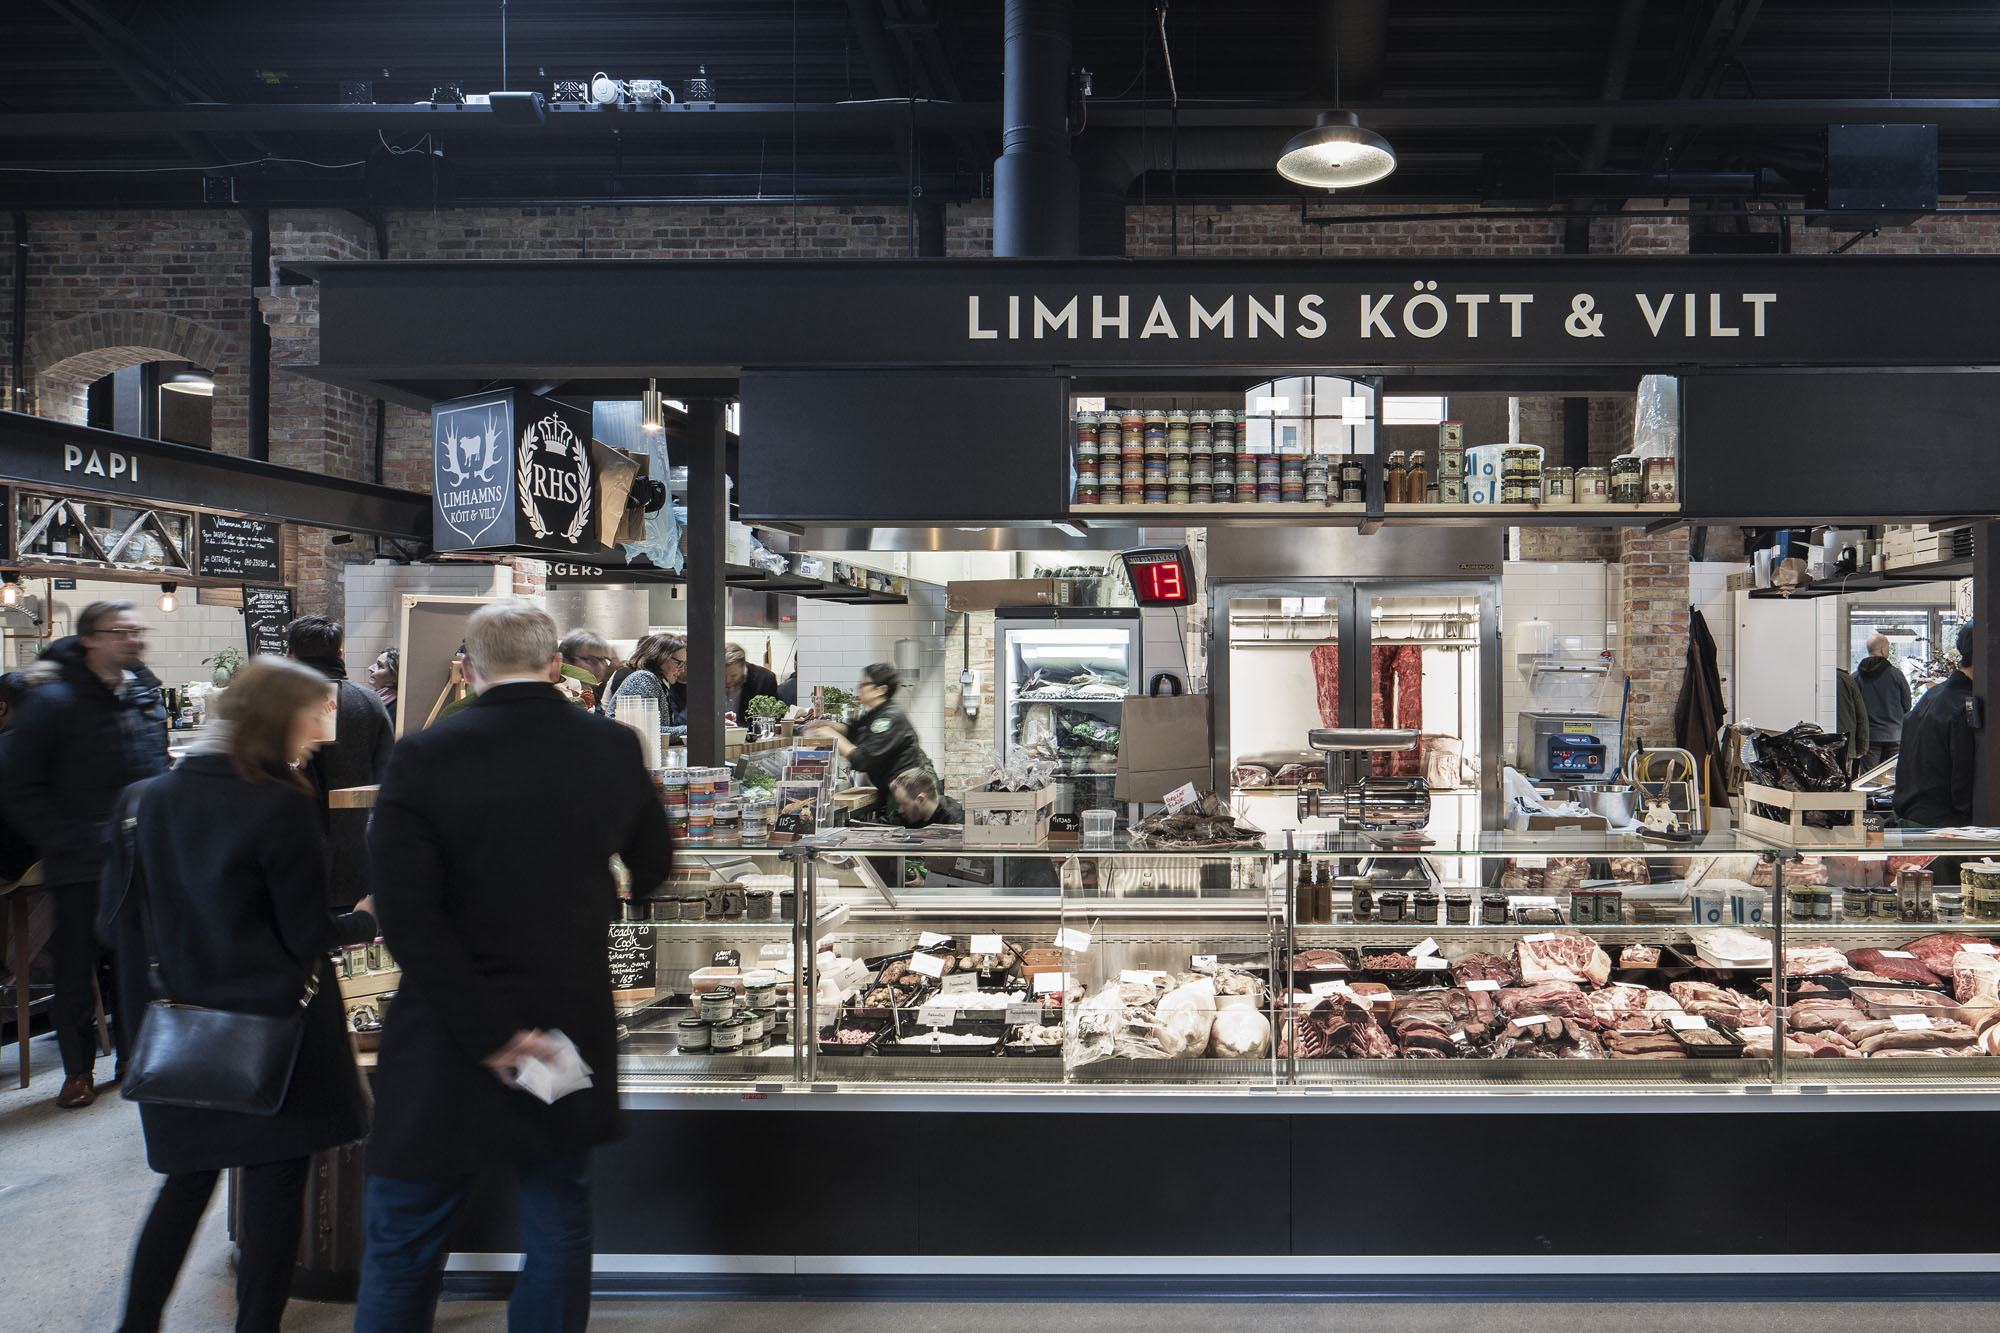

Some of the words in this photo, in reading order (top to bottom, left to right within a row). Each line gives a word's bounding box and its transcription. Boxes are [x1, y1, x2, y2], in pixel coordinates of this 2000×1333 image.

[968, 294, 1327, 339] LIMHAMNS
[1360, 280, 1534, 338] KÖTT
[1564, 293, 1605, 338] &
[1635, 293, 1777, 337] VILT
[64, 444, 138, 482] PAPI
[532, 463, 578, 504] RHS
[443, 486, 502, 508] LIMHAMNS
[451, 509, 470, 523] KÖTT
[470, 509, 479, 521] &
[480, 507, 496, 519] VILT
[546, 562, 603, 576] RGERS
[1152, 564, 1181, 598] 13
[608, 926, 635, 941] Ready
[638, 926, 649, 935] to
[614, 936, 641, 948] Cook
